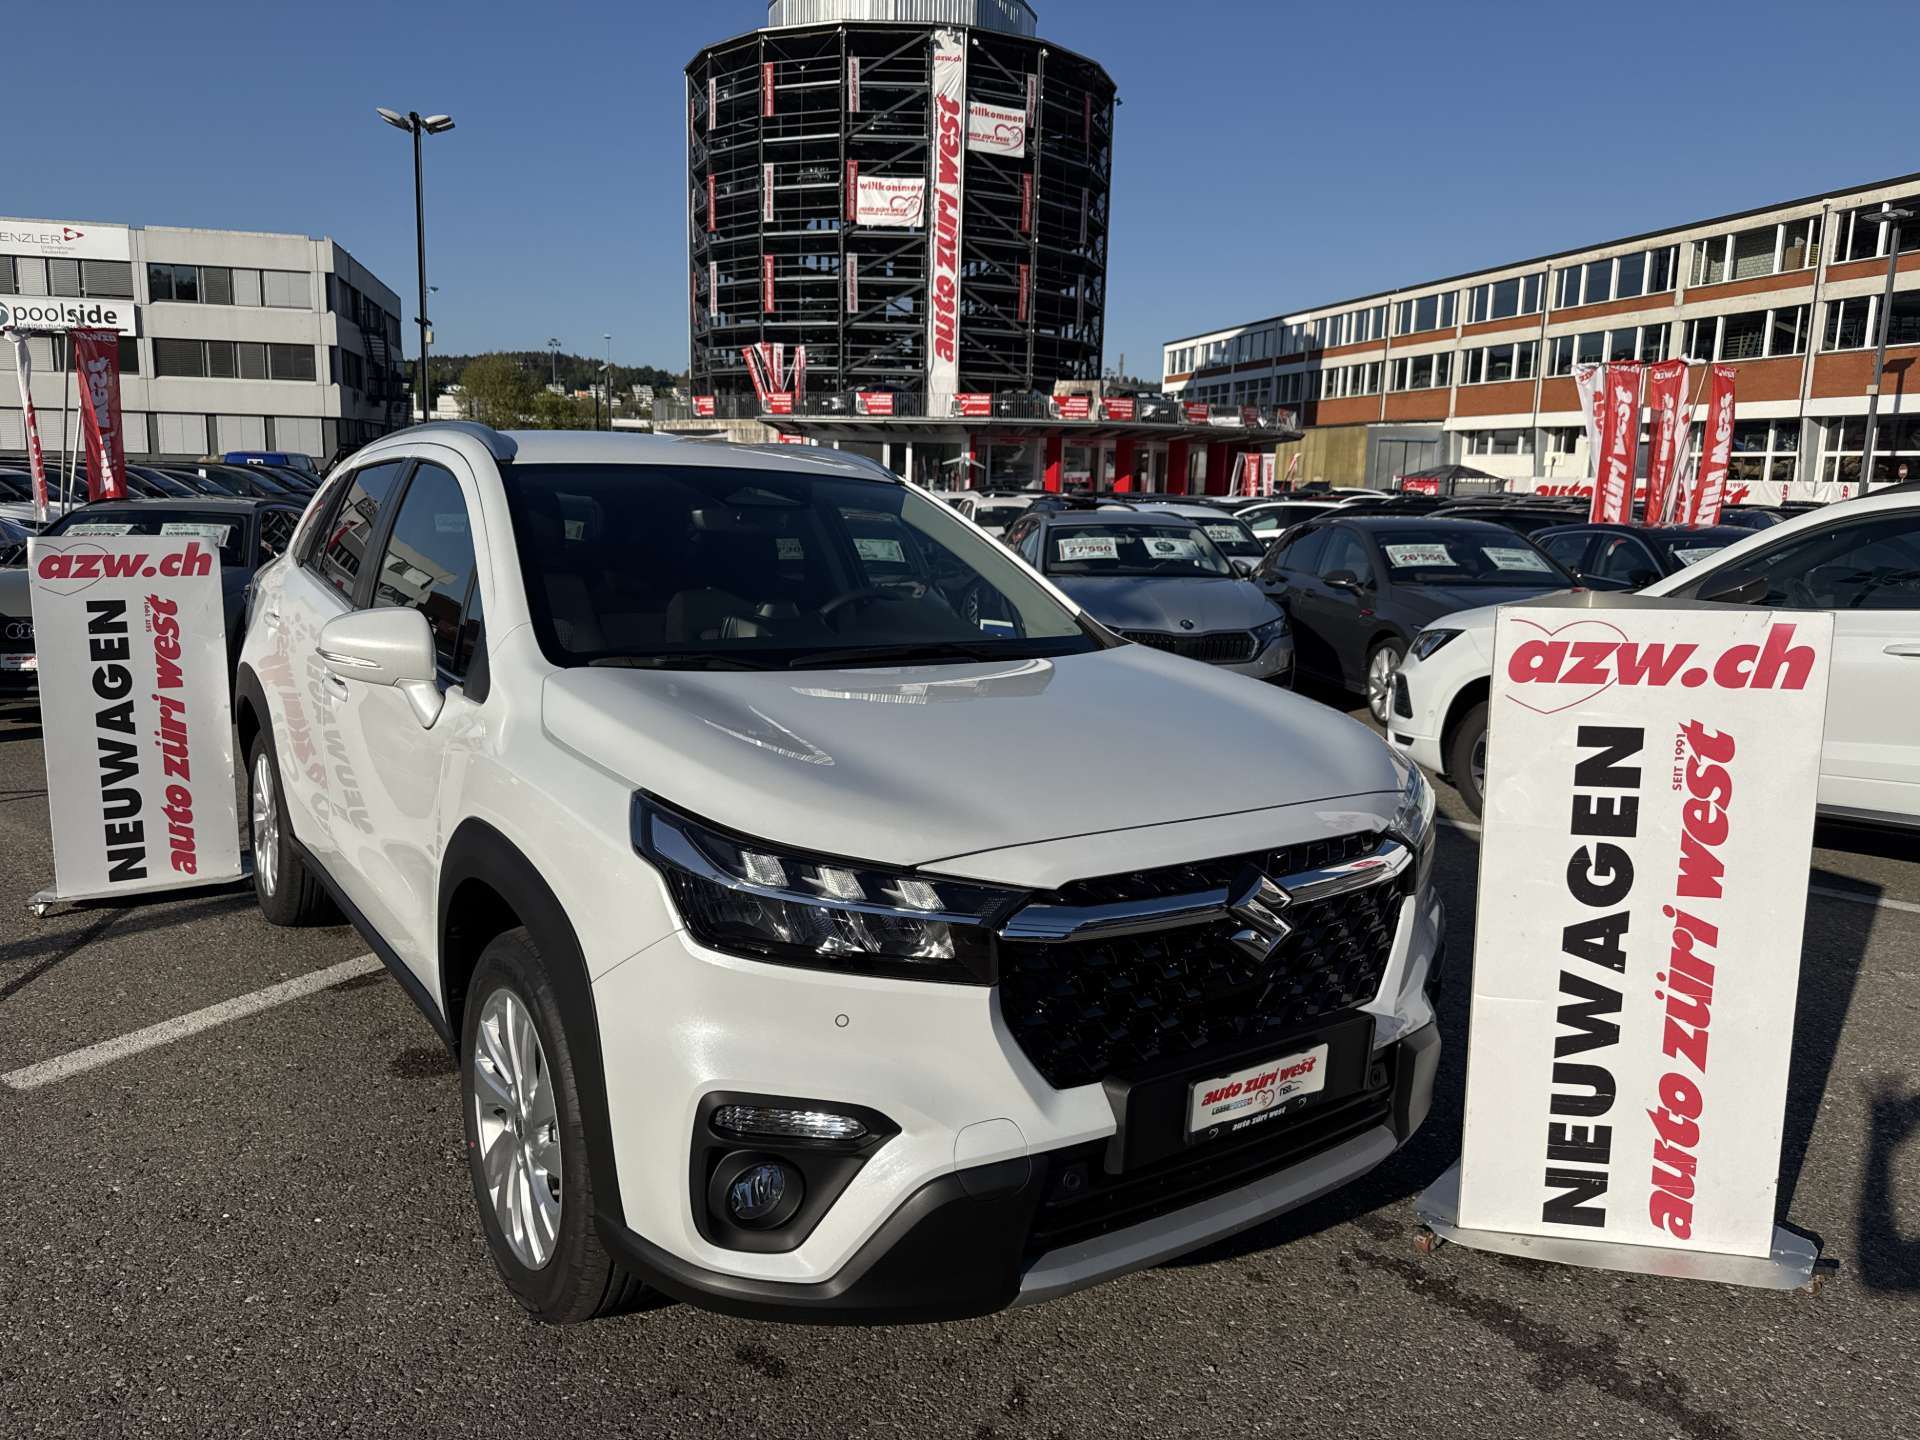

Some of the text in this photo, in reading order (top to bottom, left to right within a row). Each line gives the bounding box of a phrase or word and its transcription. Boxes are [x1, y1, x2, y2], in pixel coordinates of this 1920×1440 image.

[859, 182, 923, 193] willkommen
[0, 232, 61, 245] ENZLER
[933, 93, 961, 363] auto züri west
[13, 302, 118, 327] poolside
[1603, 385, 1633, 522] züri west
[38, 542, 212, 579] azw.ch
[1508, 623, 1816, 690] azw.ch
[86, 599, 148, 883] NEUWAGEN
[148, 593, 197, 875] auto züri west
[1673, 732, 1687, 792] SEIT 1991
[1542, 725, 1645, 1228] NEUWAGEN
[1646, 719, 1736, 1241] auto züri west
[1201, 1082, 1242, 1107] auto
[1243, 1067, 1280, 1094] züri
[1279, 1055, 1317, 1082] west
[1232, 1119, 1251, 1131] auto
[1269, 1106, 1287, 1119] west
